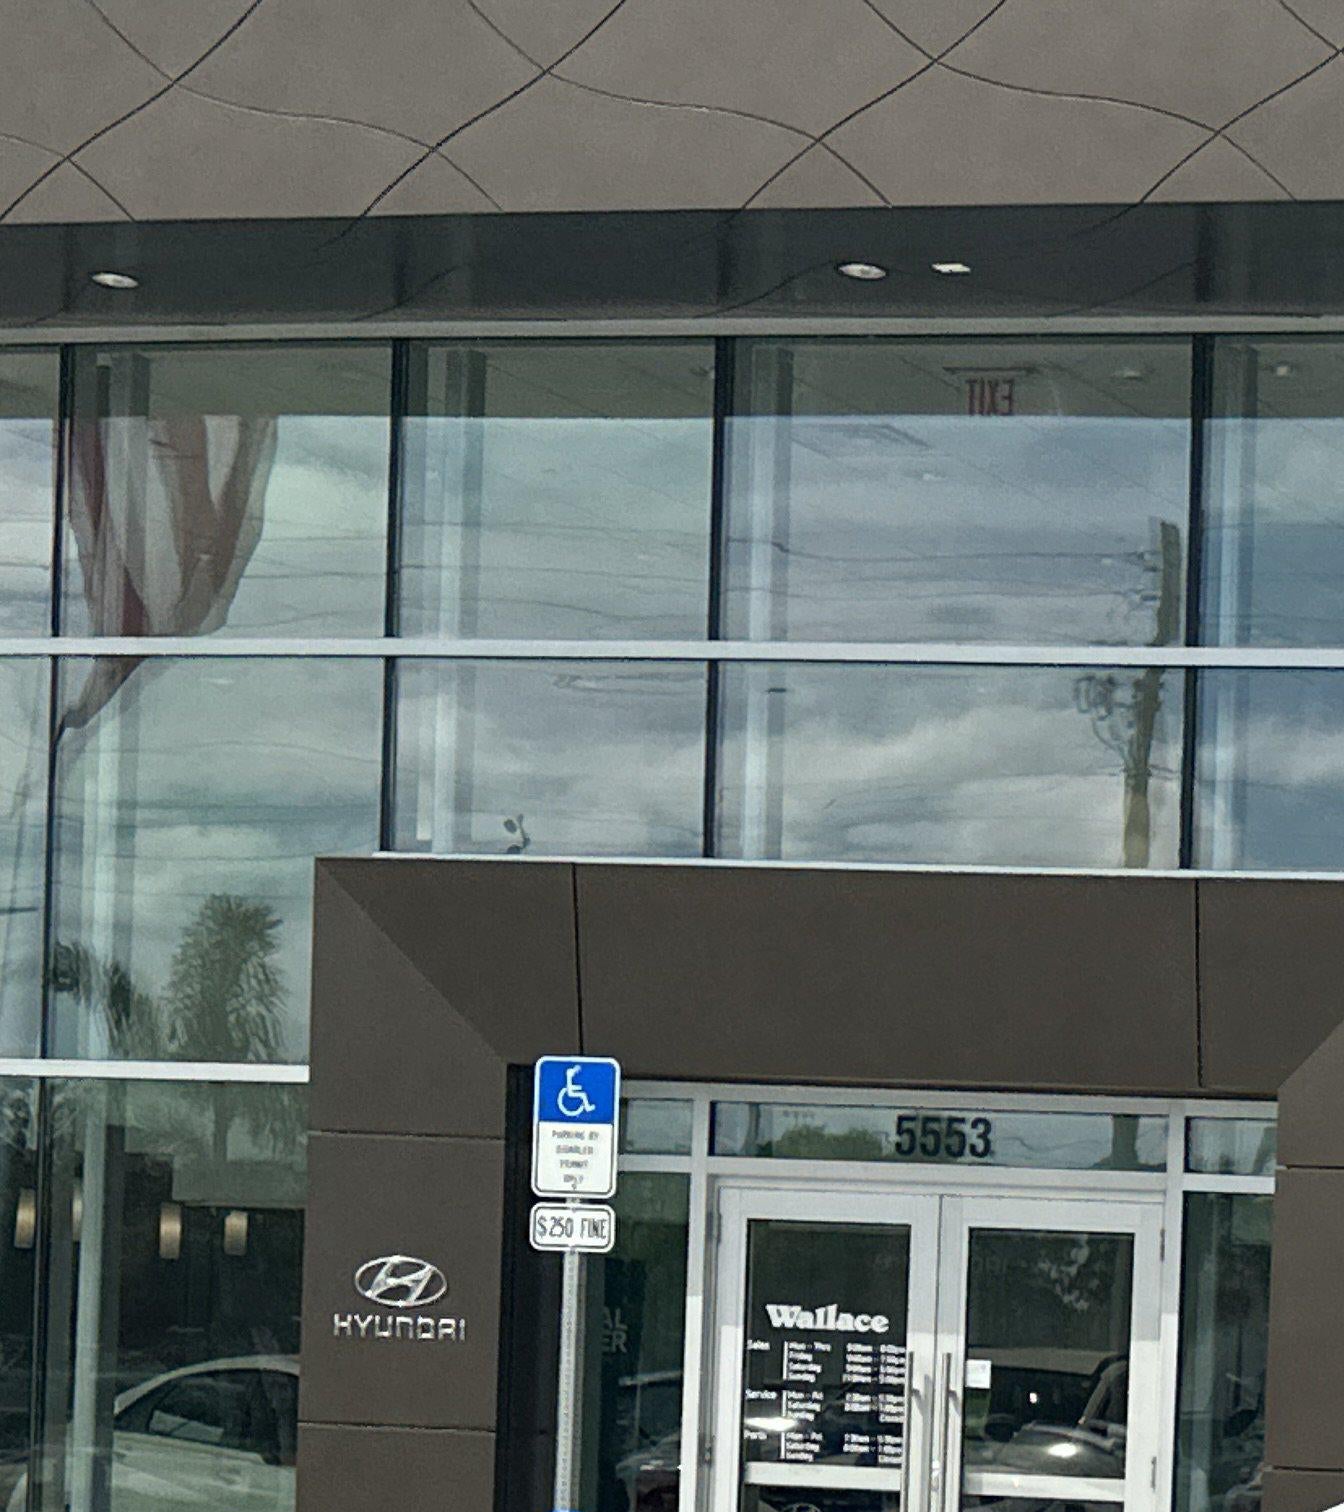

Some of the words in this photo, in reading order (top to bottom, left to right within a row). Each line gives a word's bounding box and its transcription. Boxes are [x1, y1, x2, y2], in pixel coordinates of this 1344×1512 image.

[895, 1114, 992, 1159] 5553
[537, 1215, 574, 1239] $250
[580, 1218, 608, 1240] FINE
[333, 1313, 466, 1342] HYUNDAI
[765, 1303, 890, 1333] Wallace
